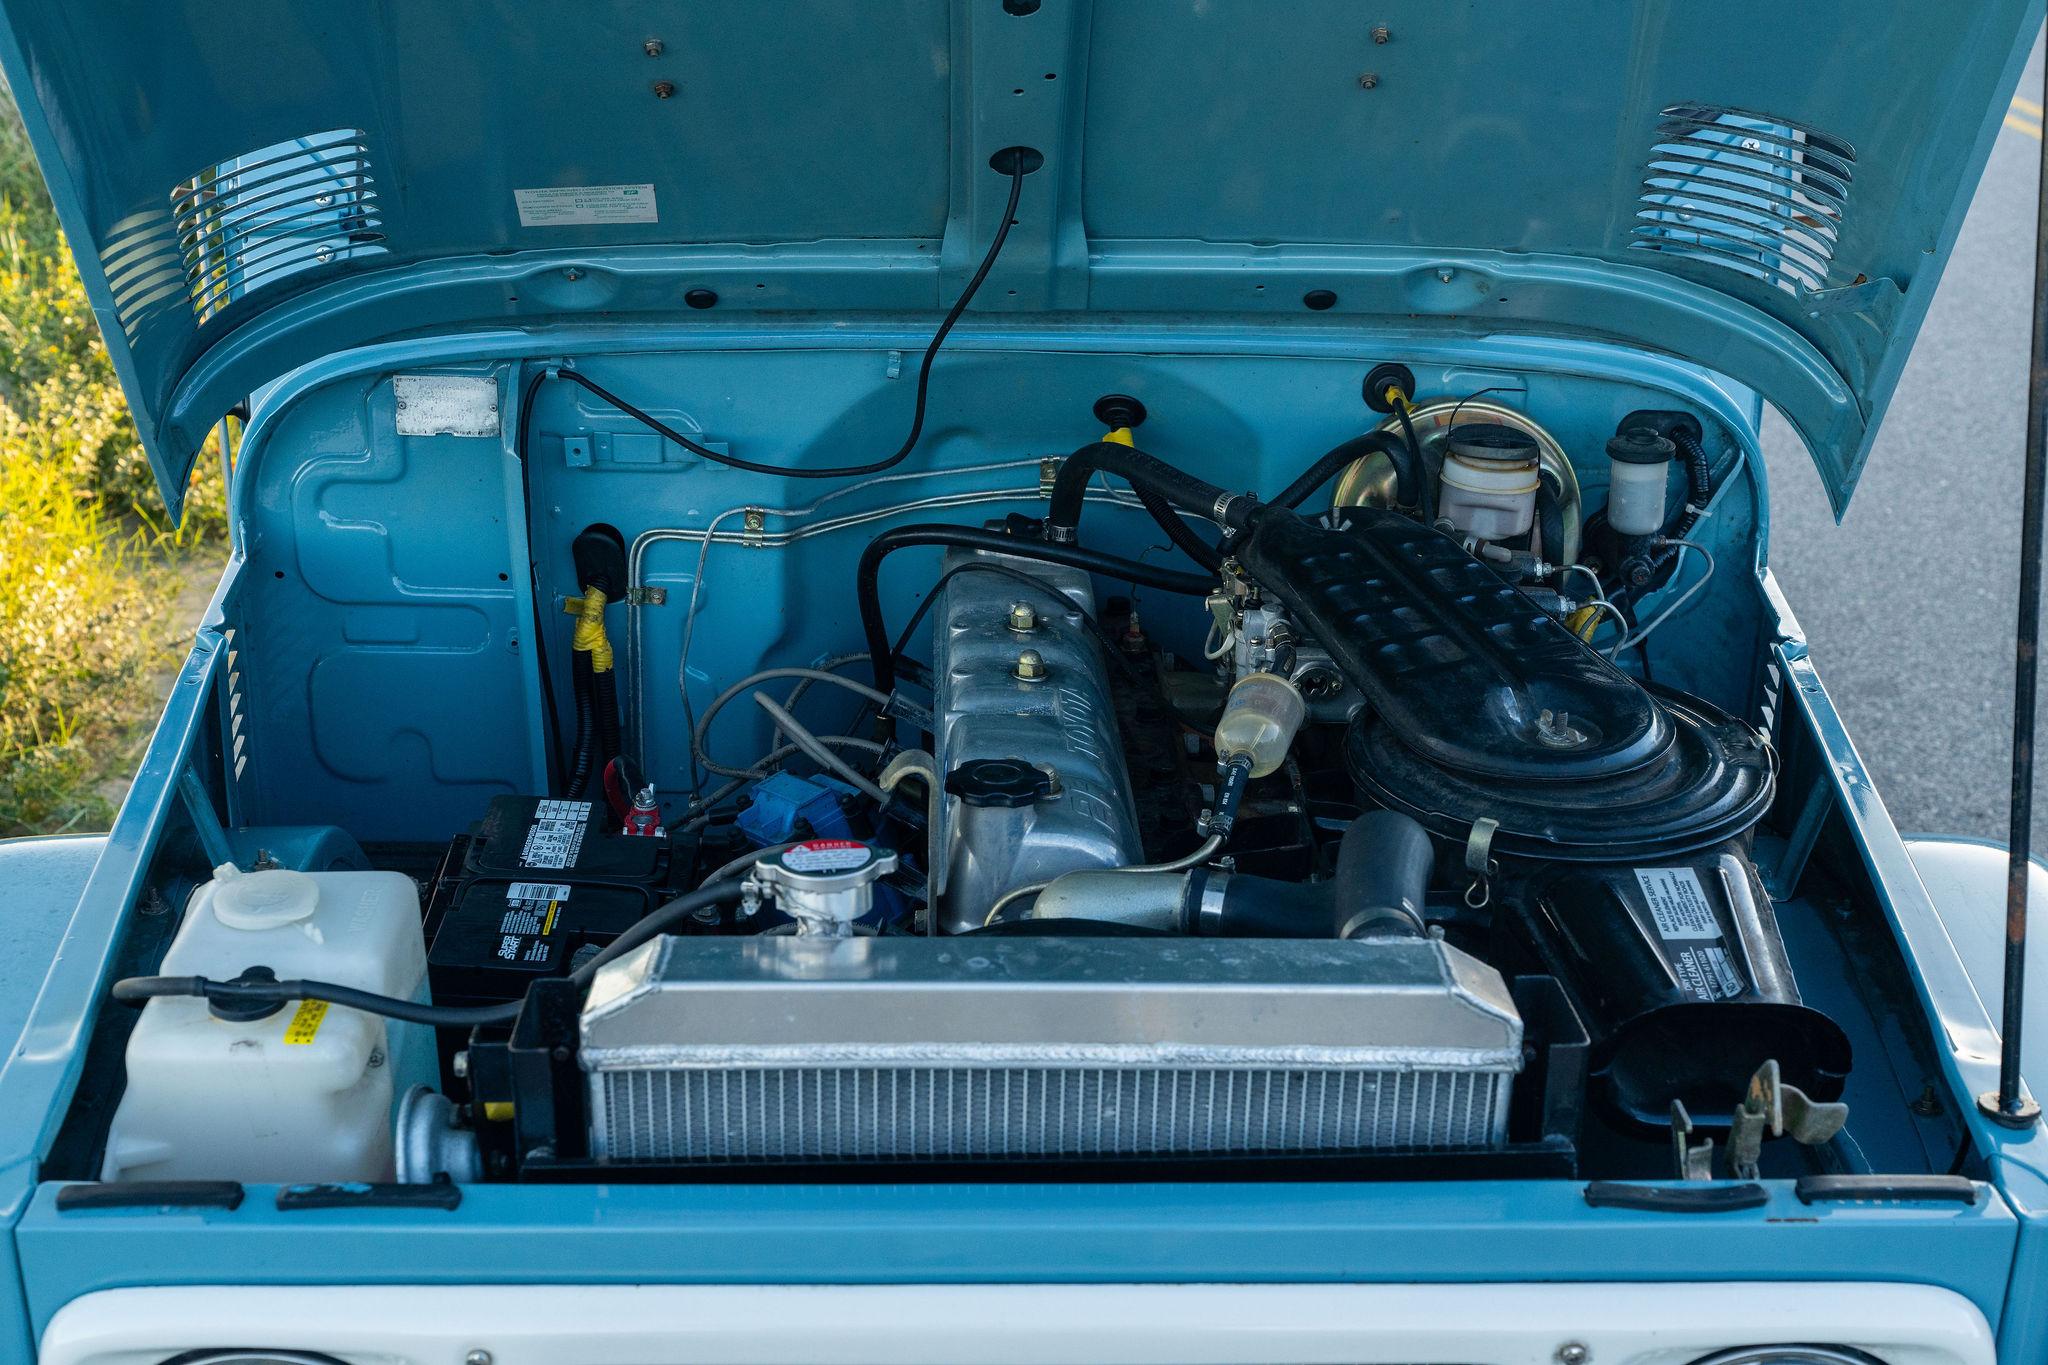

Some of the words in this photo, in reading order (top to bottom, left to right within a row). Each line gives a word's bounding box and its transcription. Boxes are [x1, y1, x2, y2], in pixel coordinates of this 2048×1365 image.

[1640, 875, 1656, 896] SERVICE
[1650, 897, 1666, 921] CLEANER
[1660, 922, 1671, 932] AIR
[498, 935, 511, 956] SUPER
[504, 935, 521, 960] START
[1680, 952, 1703, 986] CLEANER
[1694, 987, 1709, 1000] AIR
